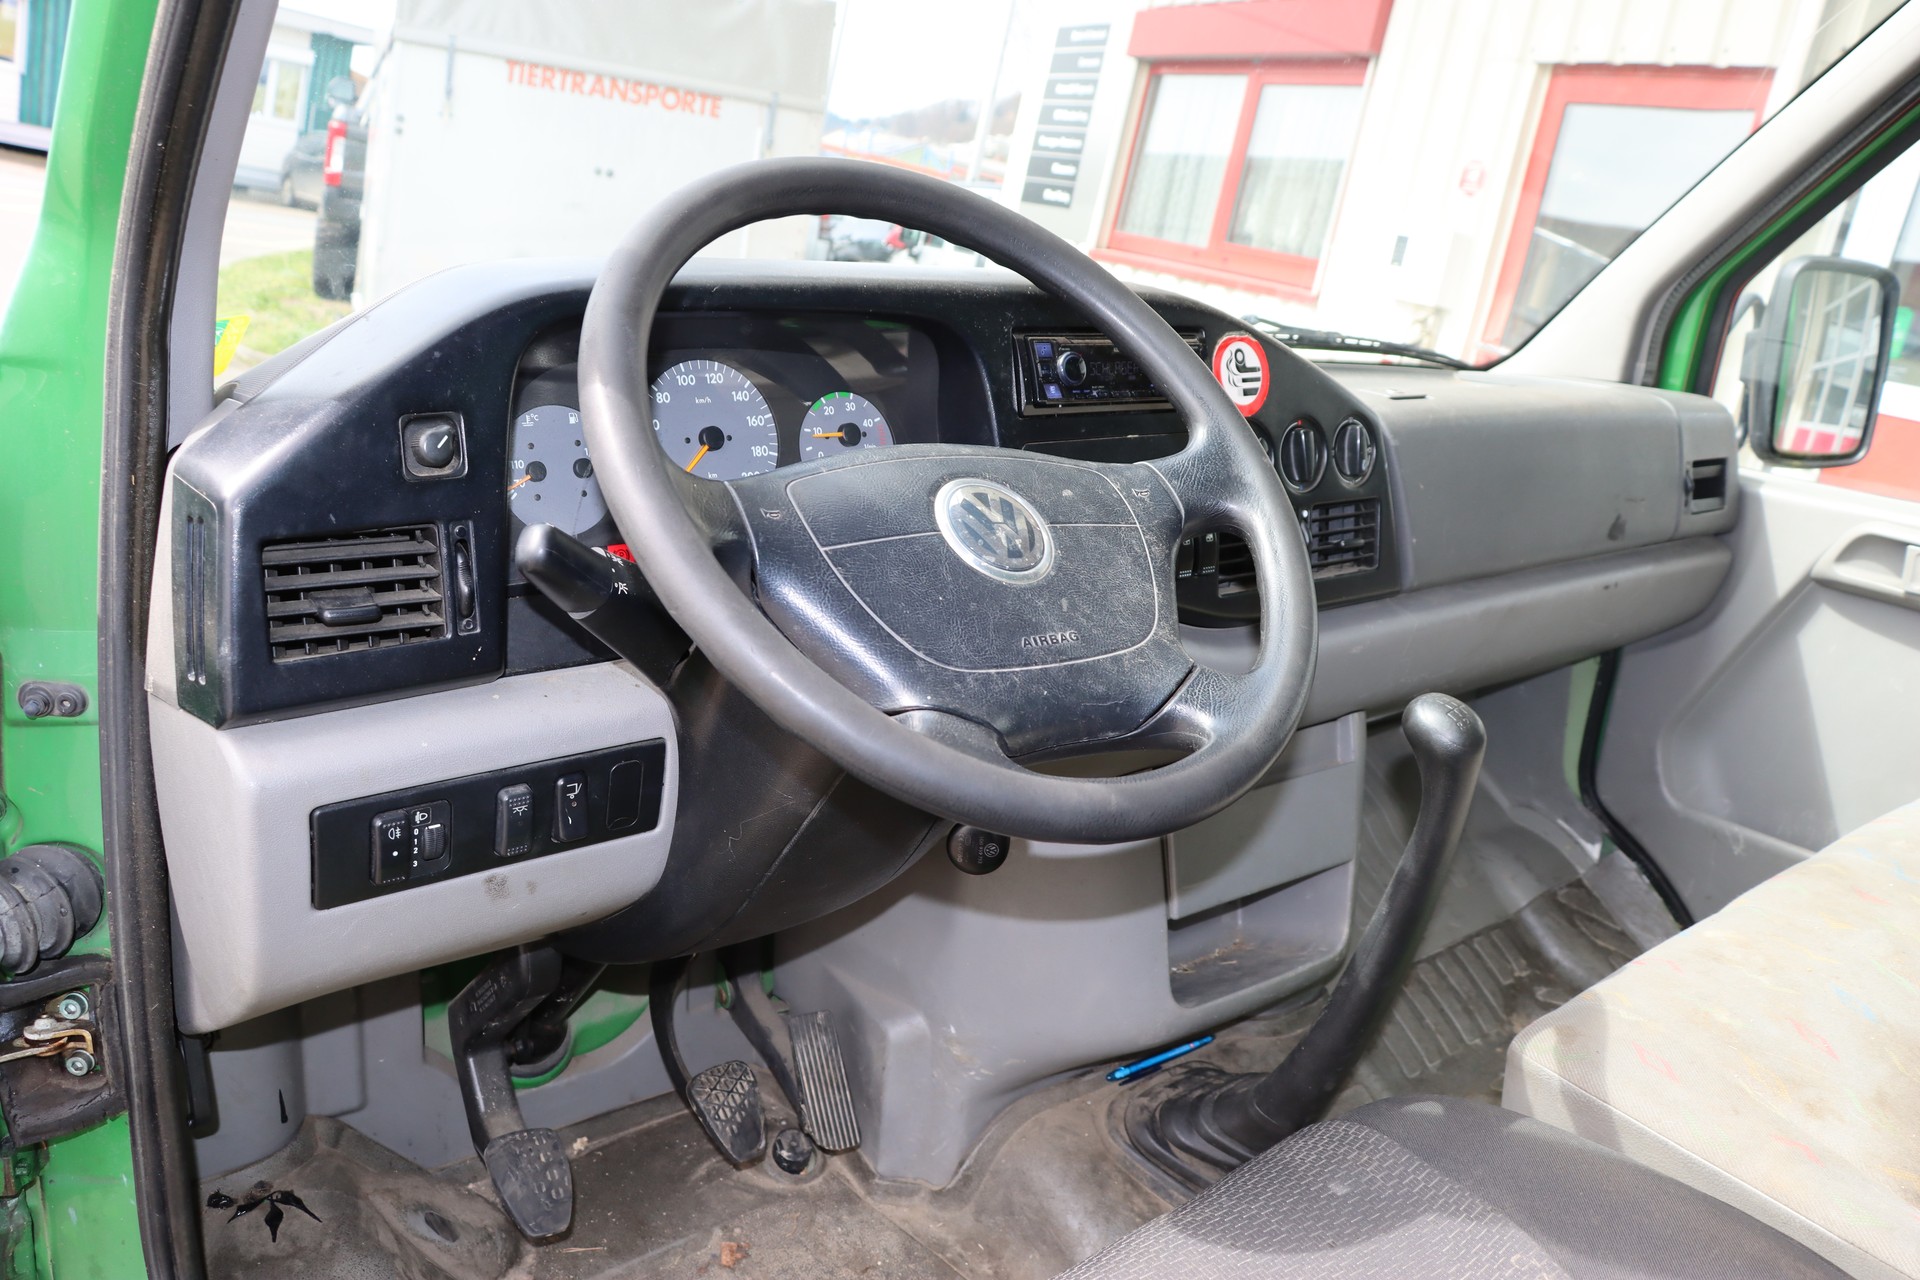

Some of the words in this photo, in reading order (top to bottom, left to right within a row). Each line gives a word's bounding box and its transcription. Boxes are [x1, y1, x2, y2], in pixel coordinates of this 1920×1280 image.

[505, 59, 723, 119] TIERTRANSPORTE
[676, 375, 696, 386] 100
[705, 373, 724, 384] 120
[655, 392, 671, 404] 80
[695, 396, 712, 404] km/h
[731, 391, 750, 402] 140
[823, 406, 834, 415] 20
[845, 402, 856, 411] 30
[652, 419, 660, 431] 0
[746, 415, 765, 427] 160
[862, 418, 873, 427] 40
[813, 427, 823, 435] 10
[751, 445, 769, 457] 180
[1020, 630, 1080, 649] AIRBAG
[413, 828, 419, 836] 0
